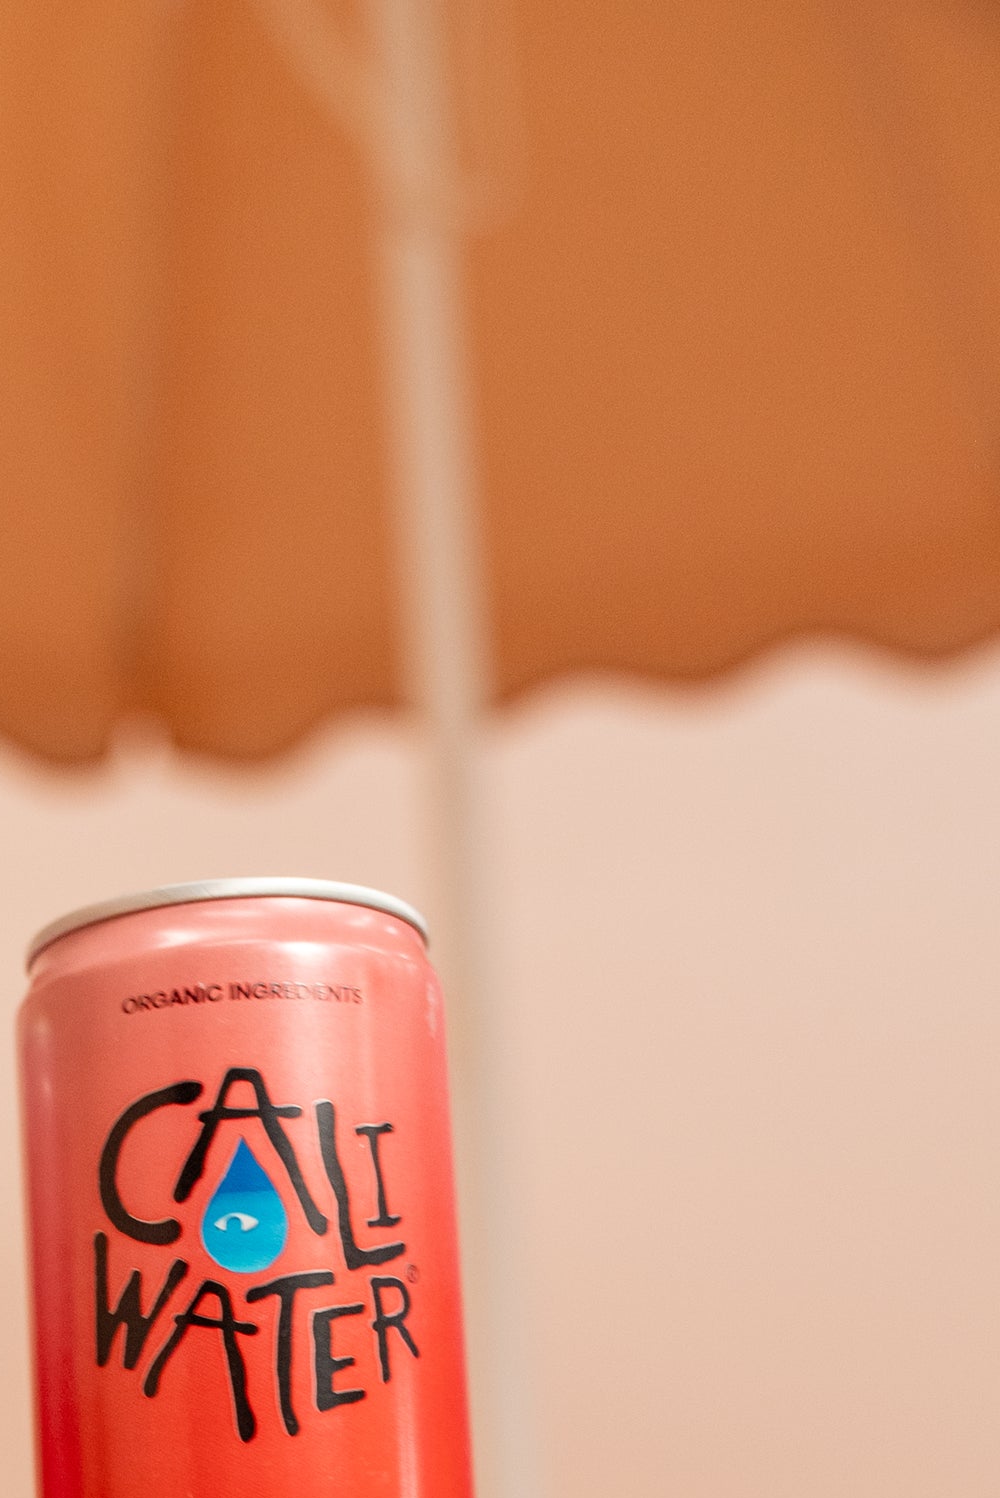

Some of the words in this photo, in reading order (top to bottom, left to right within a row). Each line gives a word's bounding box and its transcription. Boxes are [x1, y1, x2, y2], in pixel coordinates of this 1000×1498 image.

[121, 984, 222, 1015] ORGANIC
[228, 981, 364, 1004] INGREDIENTS
[98, 1067, 405, 1269] CALI
[94, 1231, 419, 1442] WATER
